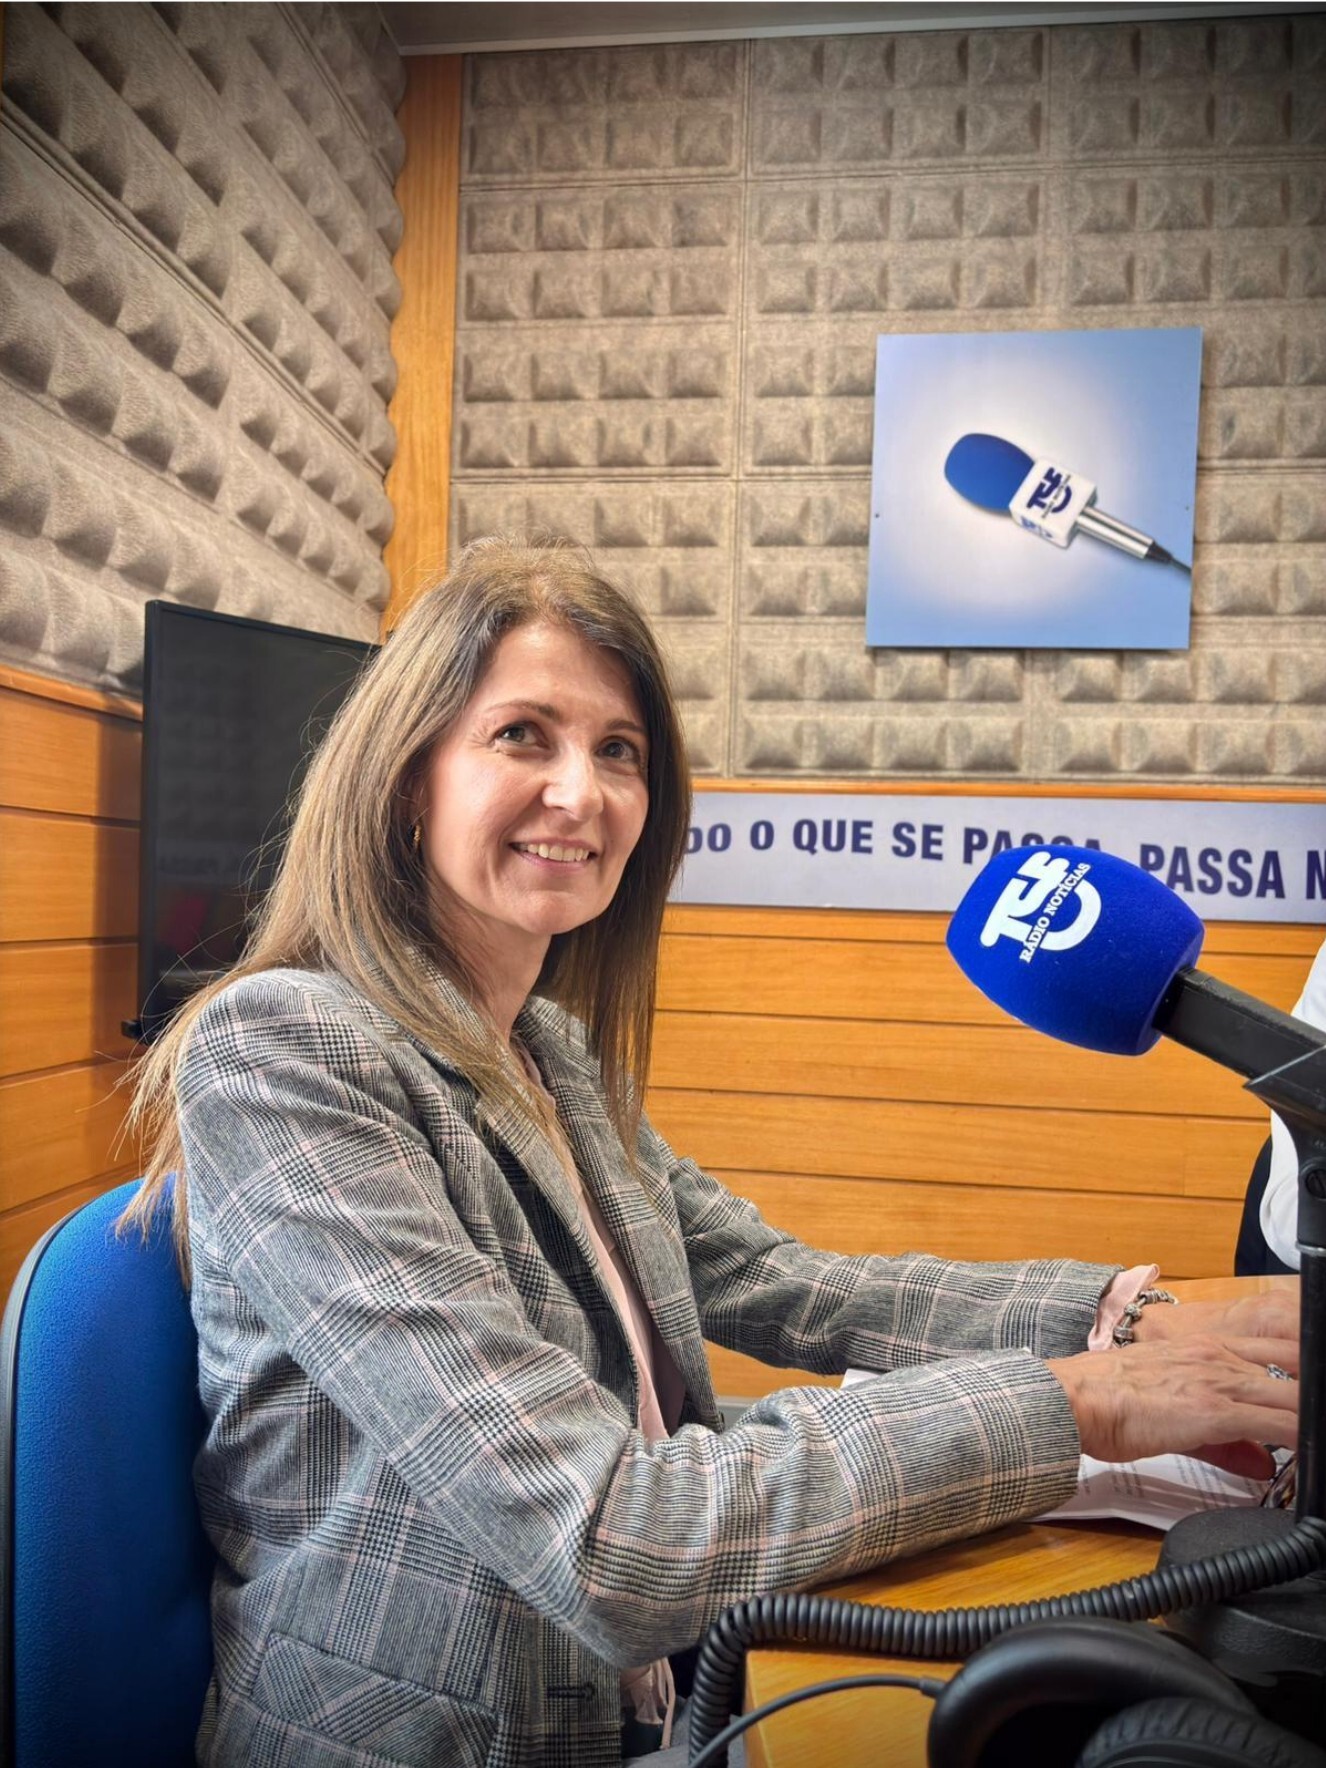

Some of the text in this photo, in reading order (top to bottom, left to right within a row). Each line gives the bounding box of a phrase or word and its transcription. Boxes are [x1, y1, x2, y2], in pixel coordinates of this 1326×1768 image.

[687, 823, 732, 854] DO
[750, 819, 775, 851] O
[793, 818, 874, 856] QUE
[891, 822, 944, 861] SE
[1139, 843, 1286, 900] PASSA
[979, 851, 1071, 948] TSF
